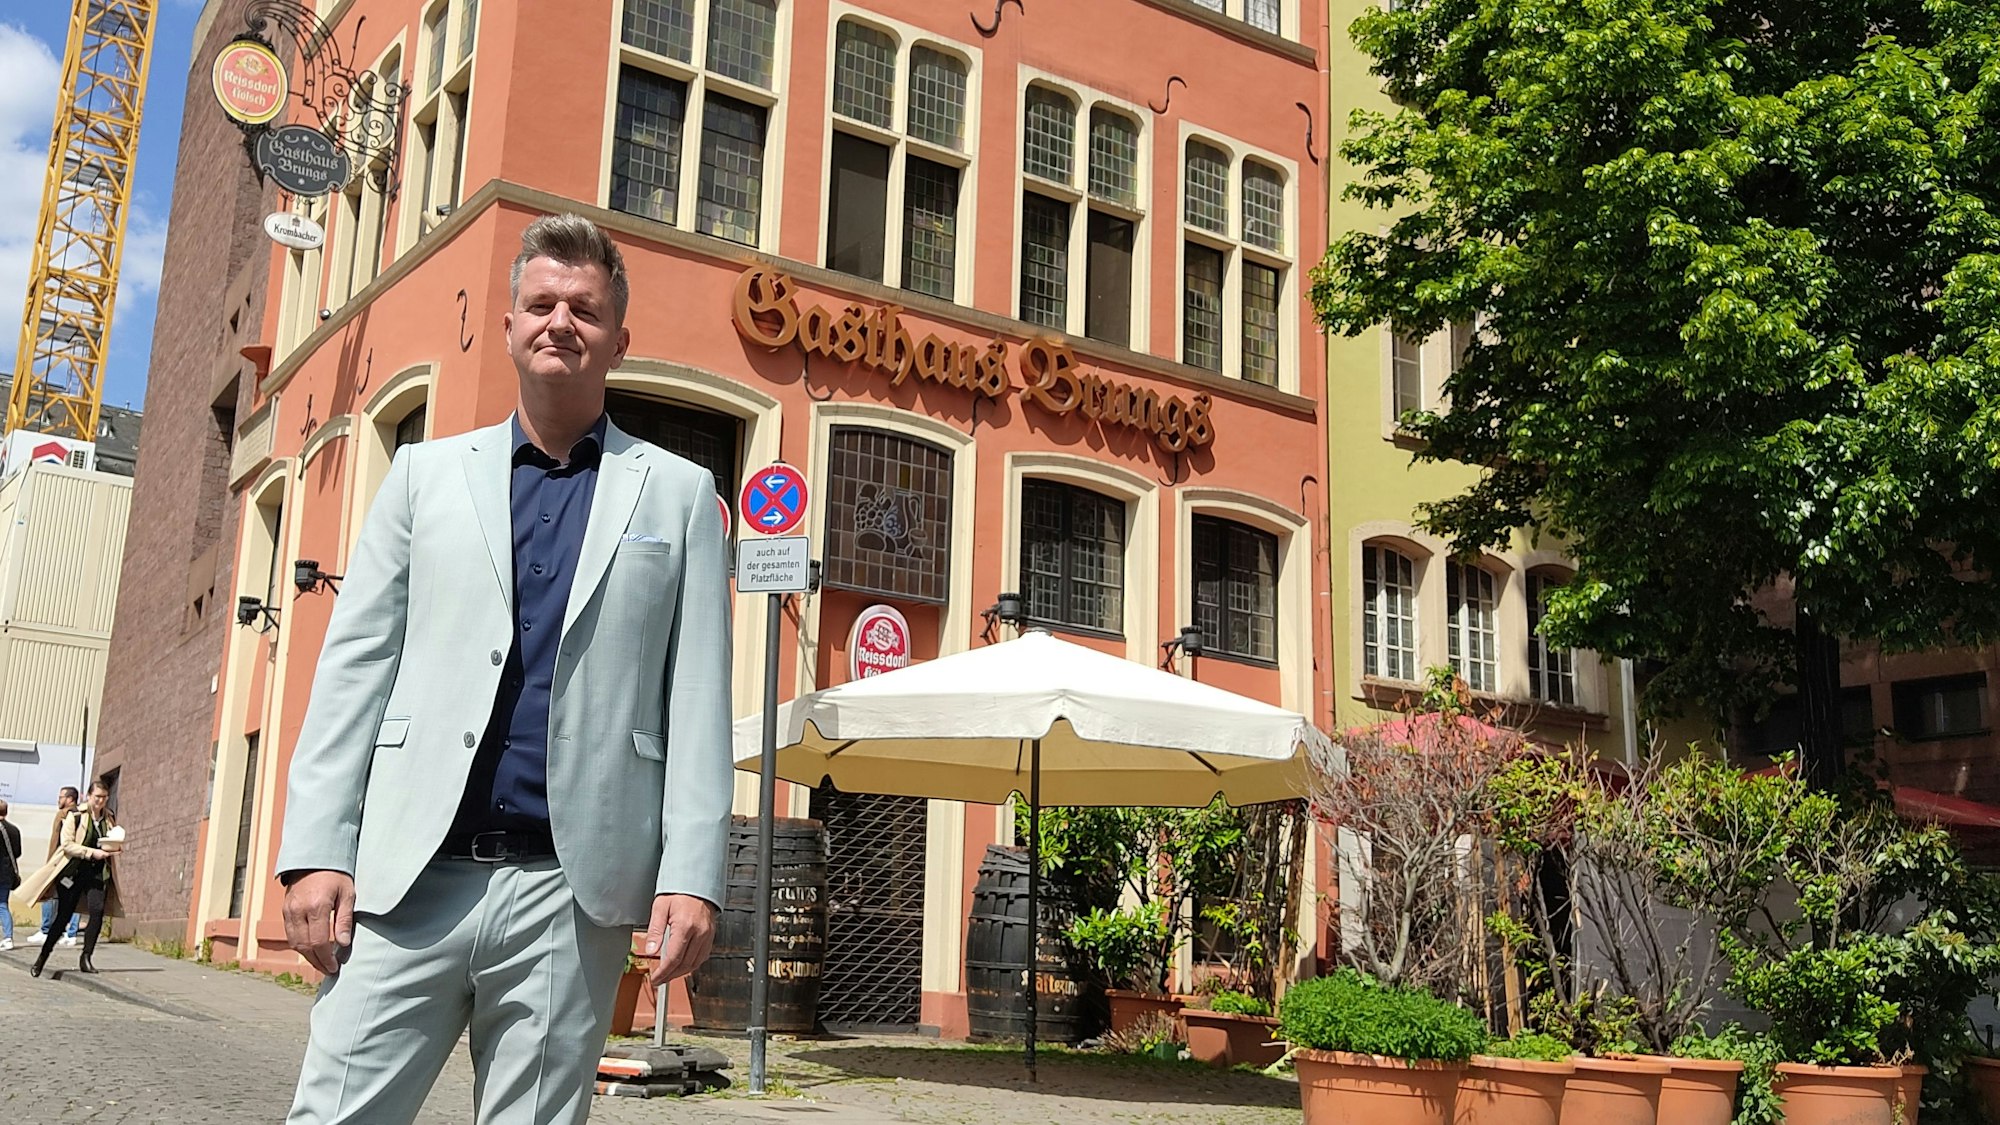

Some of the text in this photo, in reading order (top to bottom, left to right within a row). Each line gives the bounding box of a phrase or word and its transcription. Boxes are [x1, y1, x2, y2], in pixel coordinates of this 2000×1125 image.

[223, 69, 277, 96] Reissdorf
[268, 139, 339, 170] Gasthaus
[277, 158, 328, 181] Brungs
[274, 223, 318, 243] Krombacher
[732, 264, 1213, 454] Gasthaus Brungs
[756, 547, 791, 557] auch auf
[746, 561, 800, 574] der gesamten
[750, 573, 794, 584] Platzfläche
[859, 647, 905, 668] Reissdorf
